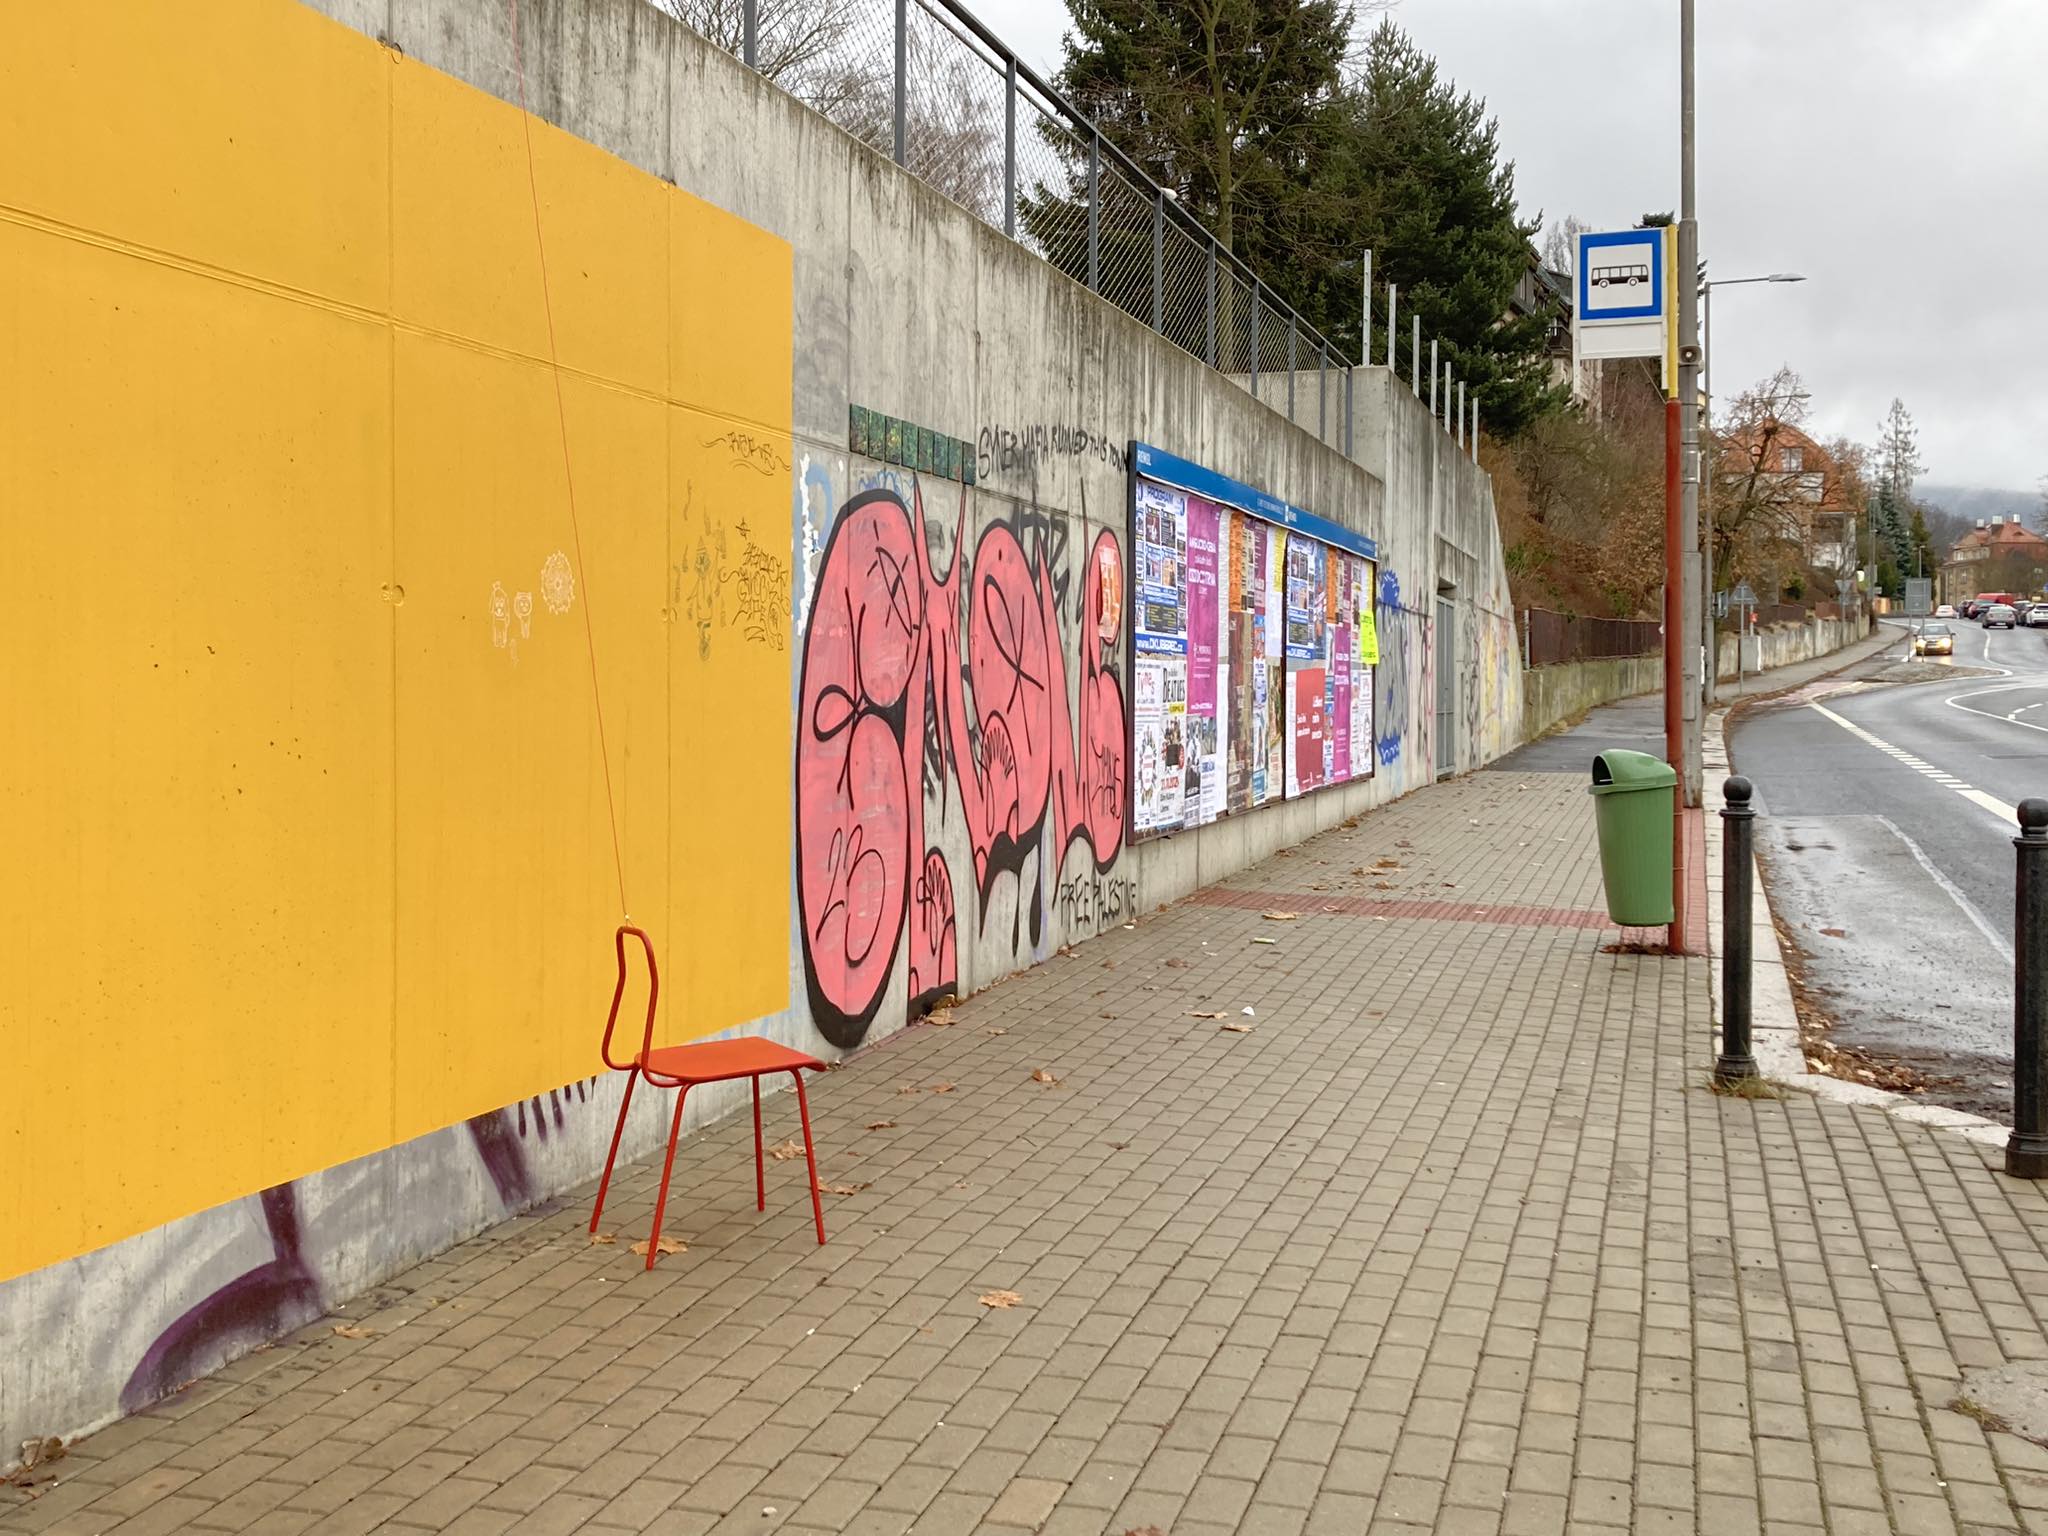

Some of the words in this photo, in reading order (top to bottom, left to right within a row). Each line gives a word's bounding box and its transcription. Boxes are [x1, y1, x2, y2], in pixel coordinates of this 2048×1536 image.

[1022, 424, 1049, 471] MAFIA
[1050, 423, 1088, 457] RUINED
[1089, 435, 1107, 462] THIS
[1109, 443, 1129, 472] TOWN
[1147, 485, 1174, 504] PROGRAM
[1061, 873, 1090, 932] FREE
[1093, 878, 1136, 931] PALESTINE
